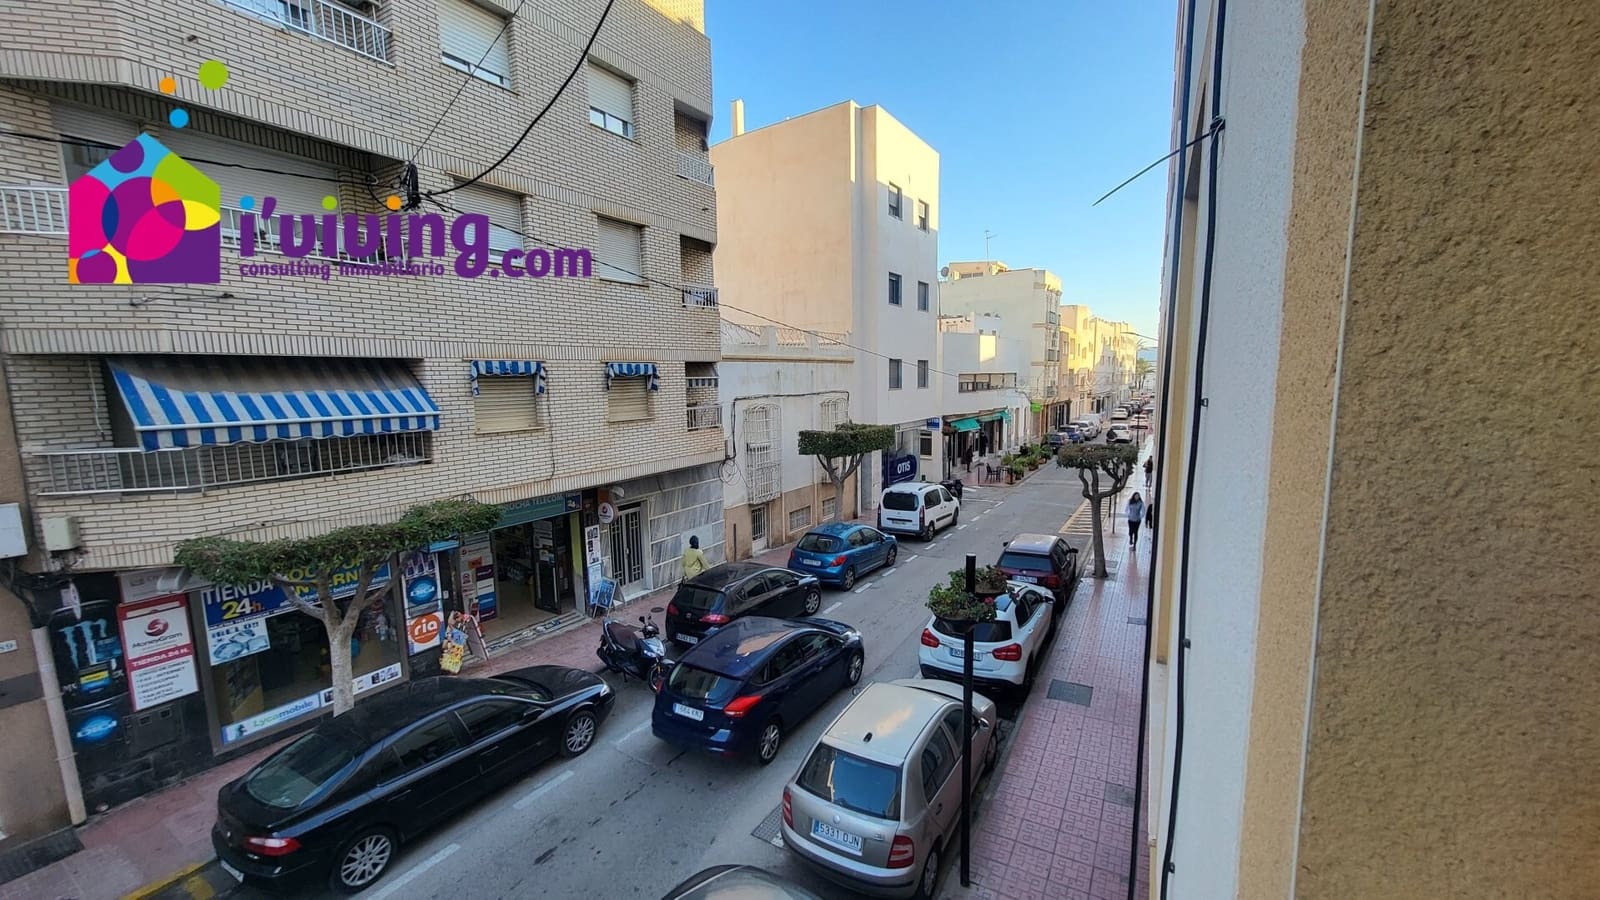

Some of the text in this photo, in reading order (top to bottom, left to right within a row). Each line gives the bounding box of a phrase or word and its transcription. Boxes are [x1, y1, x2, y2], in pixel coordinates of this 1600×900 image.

[897, 460, 911, 474] OTIS
[202, 579, 274, 605] TIENDA
[414, 617, 438, 636] ria
[131, 631, 184, 649] MoneyGram
[252, 699, 314, 728] Lycamobile
[819, 822, 839, 838] 5331
